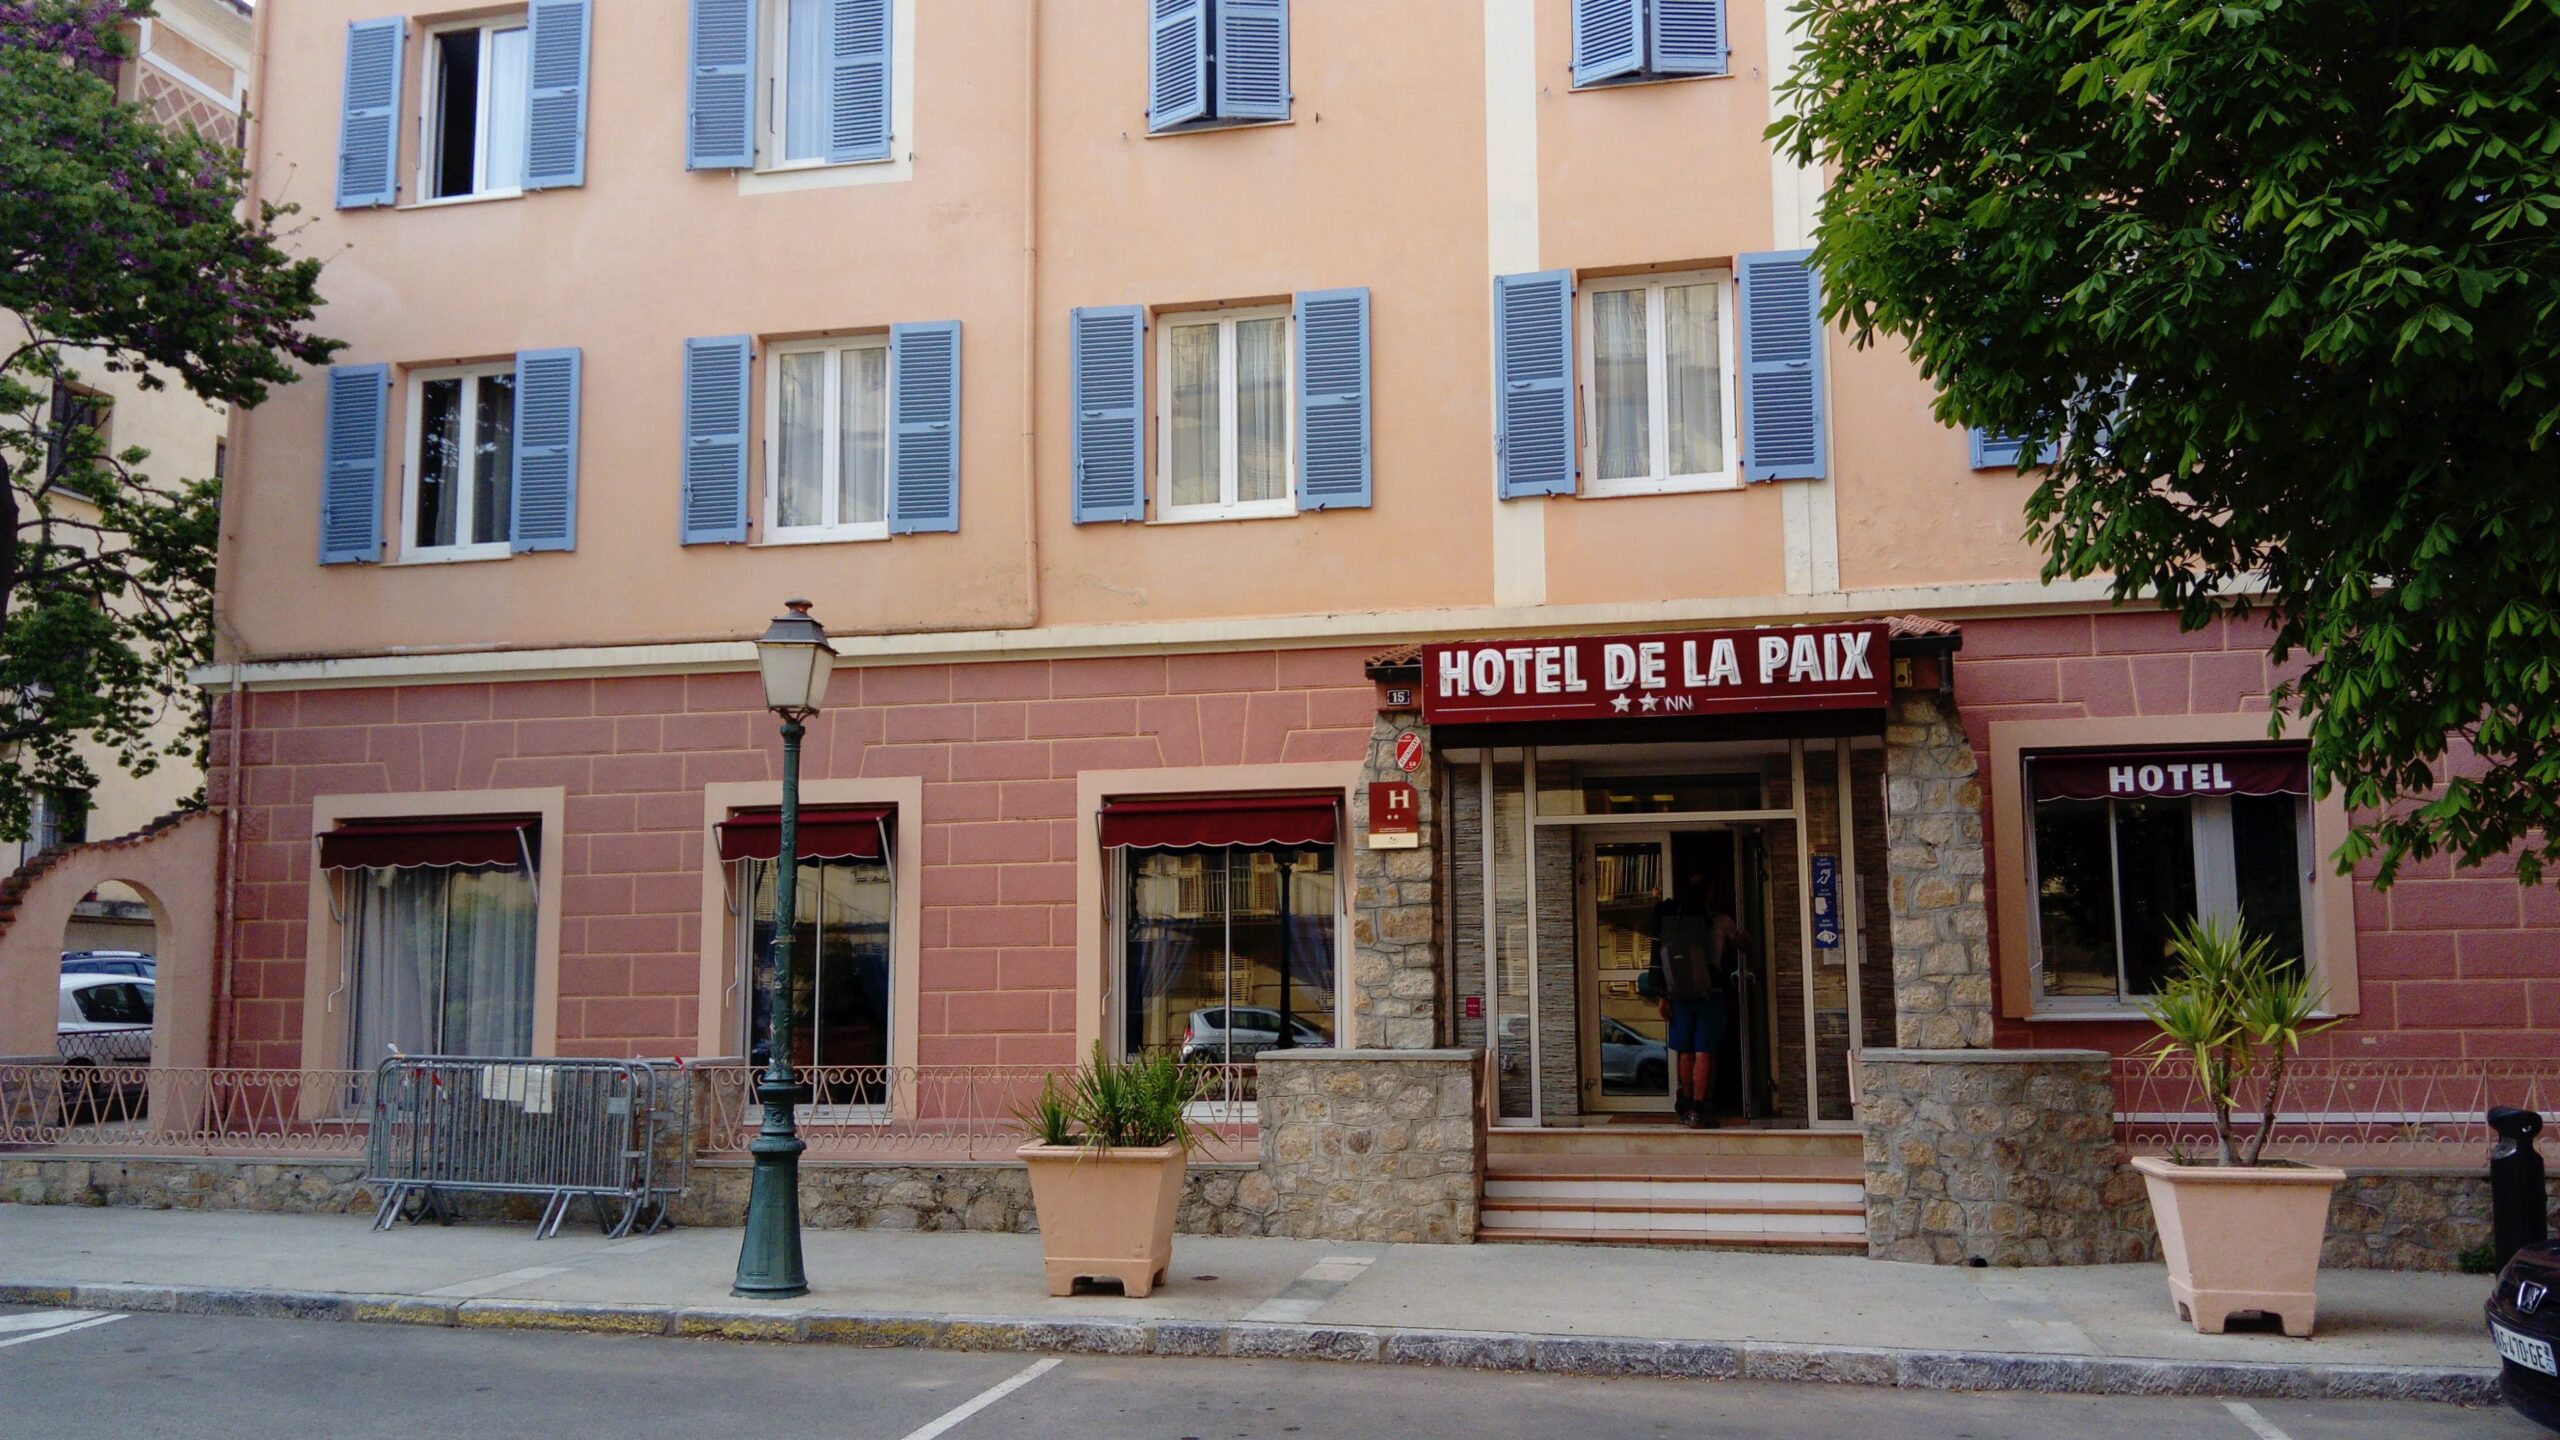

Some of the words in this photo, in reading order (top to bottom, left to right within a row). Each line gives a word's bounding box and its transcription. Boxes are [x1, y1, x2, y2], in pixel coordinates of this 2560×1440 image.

[1439, 646, 1587, 697] HOTEL
[1604, 642, 1666, 690] DE
[1683, 638, 1742, 687] LA
[1758, 632, 1874, 684] PAIX
[1392, 692, 1405, 703] 15
[1664, 695, 1694, 711] NN
[2109, 763, 2232, 792] HOTEL
[1389, 790, 1410, 809] H
